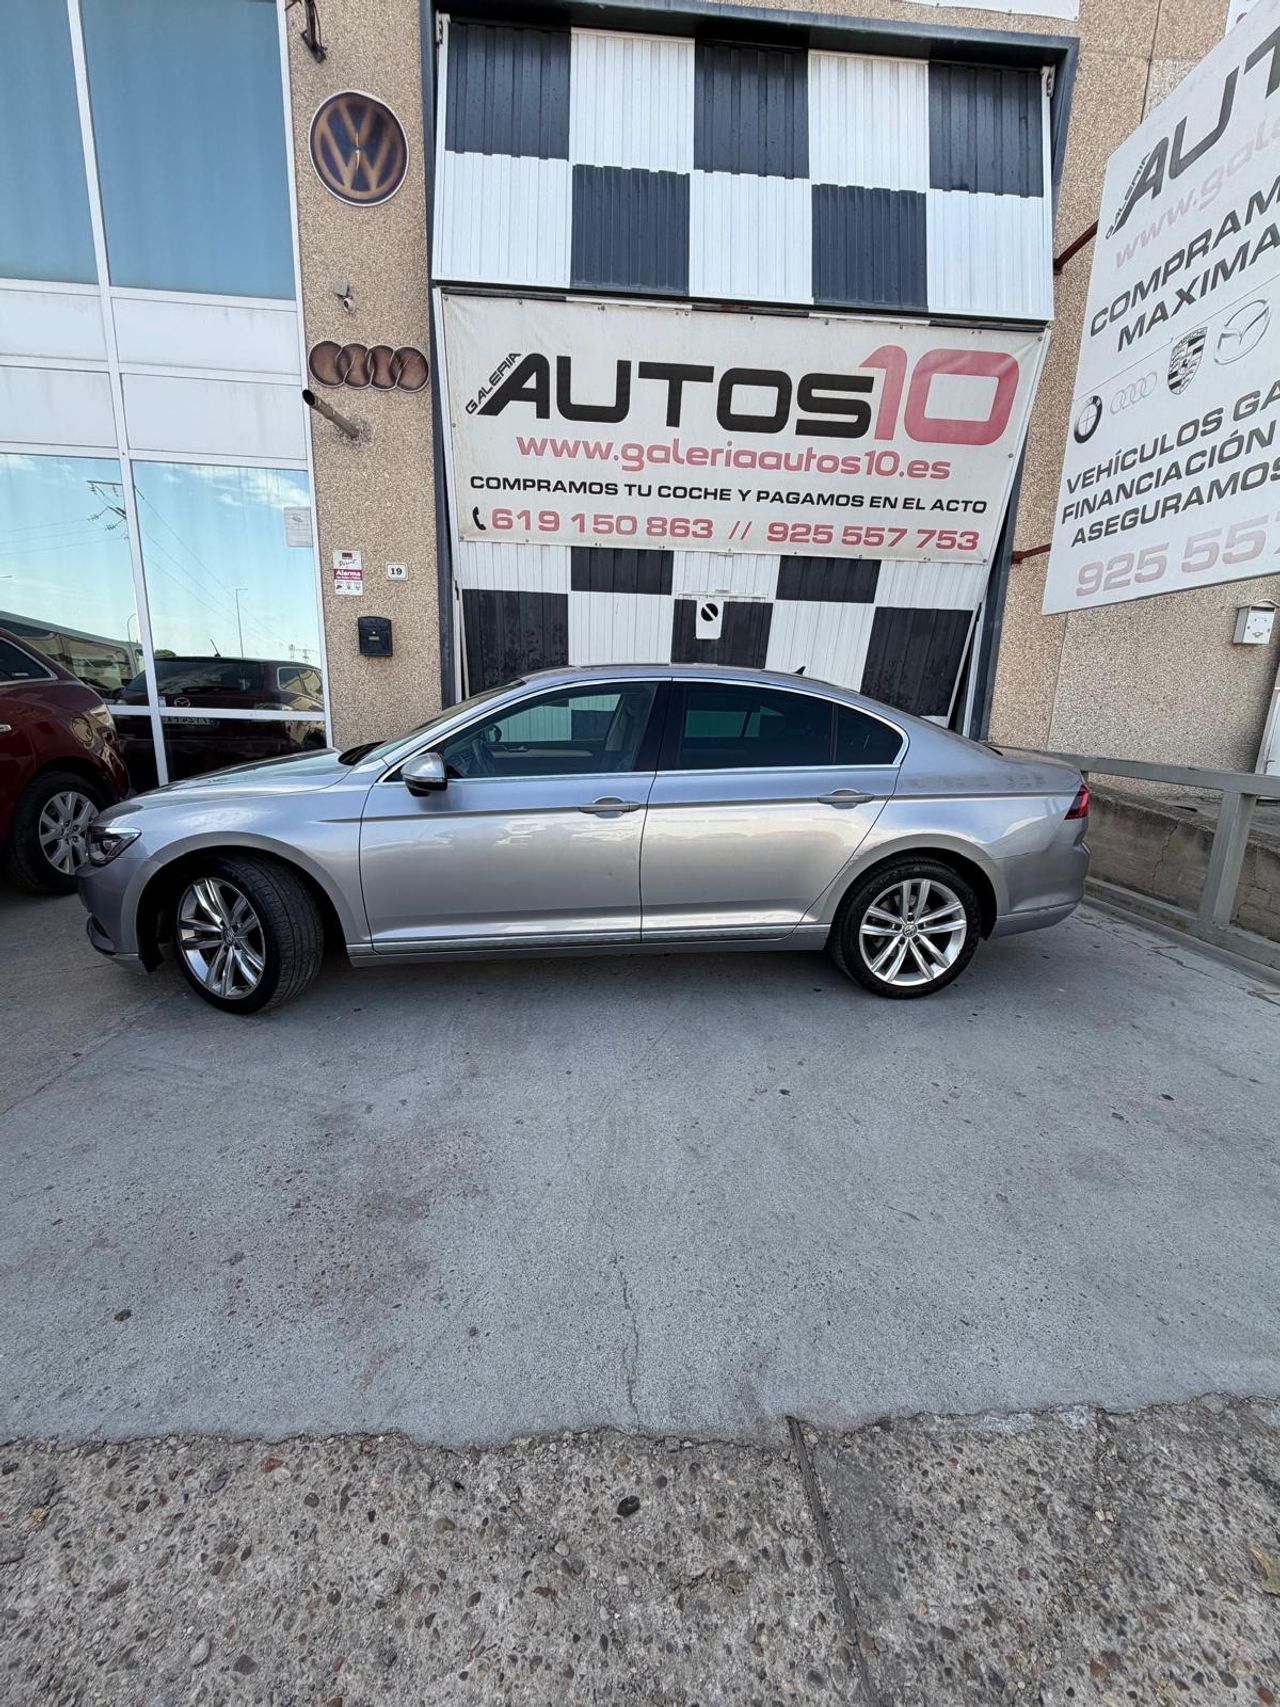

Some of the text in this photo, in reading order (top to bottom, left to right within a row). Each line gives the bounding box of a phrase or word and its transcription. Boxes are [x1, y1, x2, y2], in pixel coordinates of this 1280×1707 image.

[465, 352, 522, 415] GALERIA
[516, 436, 951, 480] www.galeriaautos10.es
[1061, 420, 1277, 525] FINANCIACIÓN
[1066, 407, 1224, 494] VEHÍCULOS
[470, 476, 988, 514] COMPRAMOS TU COCHE Y PAGAMOS EN EL ACTO
[491, 508, 560, 532] 619
[571, 512, 638, 536] 150
[646, 516, 714, 540] 863
[767, 521, 834, 544] 925
[841, 525, 908, 548] 557
[917, 528, 980, 551] 753
[336, 569, 361, 577] Alarma
[390, 567, 403, 576] 19
[1076, 542, 1170, 597] 925
